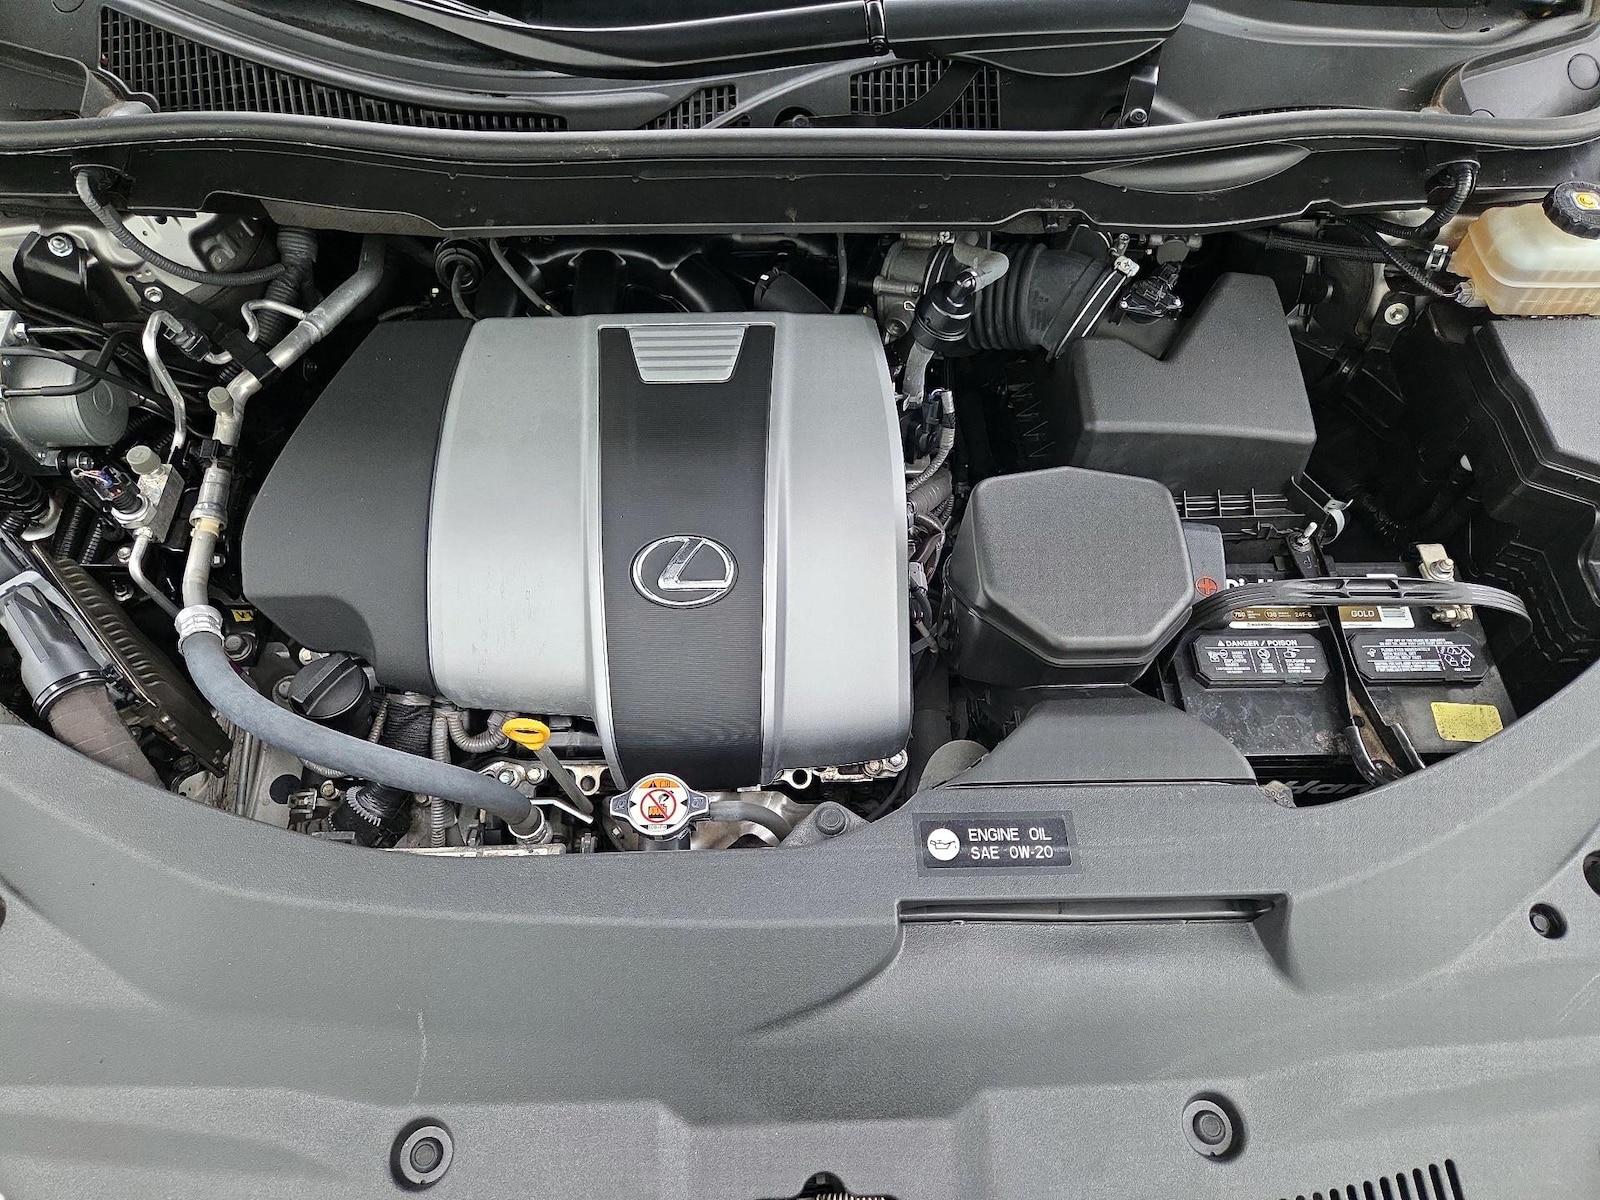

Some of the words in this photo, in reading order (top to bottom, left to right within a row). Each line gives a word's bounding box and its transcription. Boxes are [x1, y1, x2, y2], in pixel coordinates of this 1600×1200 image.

[1350, 609, 1375, 618] GOLD
[1225, 639, 1260, 647] DANGER
[968, 827, 1020, 842] ENGINE
[1028, 827, 1052, 841] OIL
[971, 846, 1000, 860] SAE
[1009, 845, 1054, 859] 0W-20
